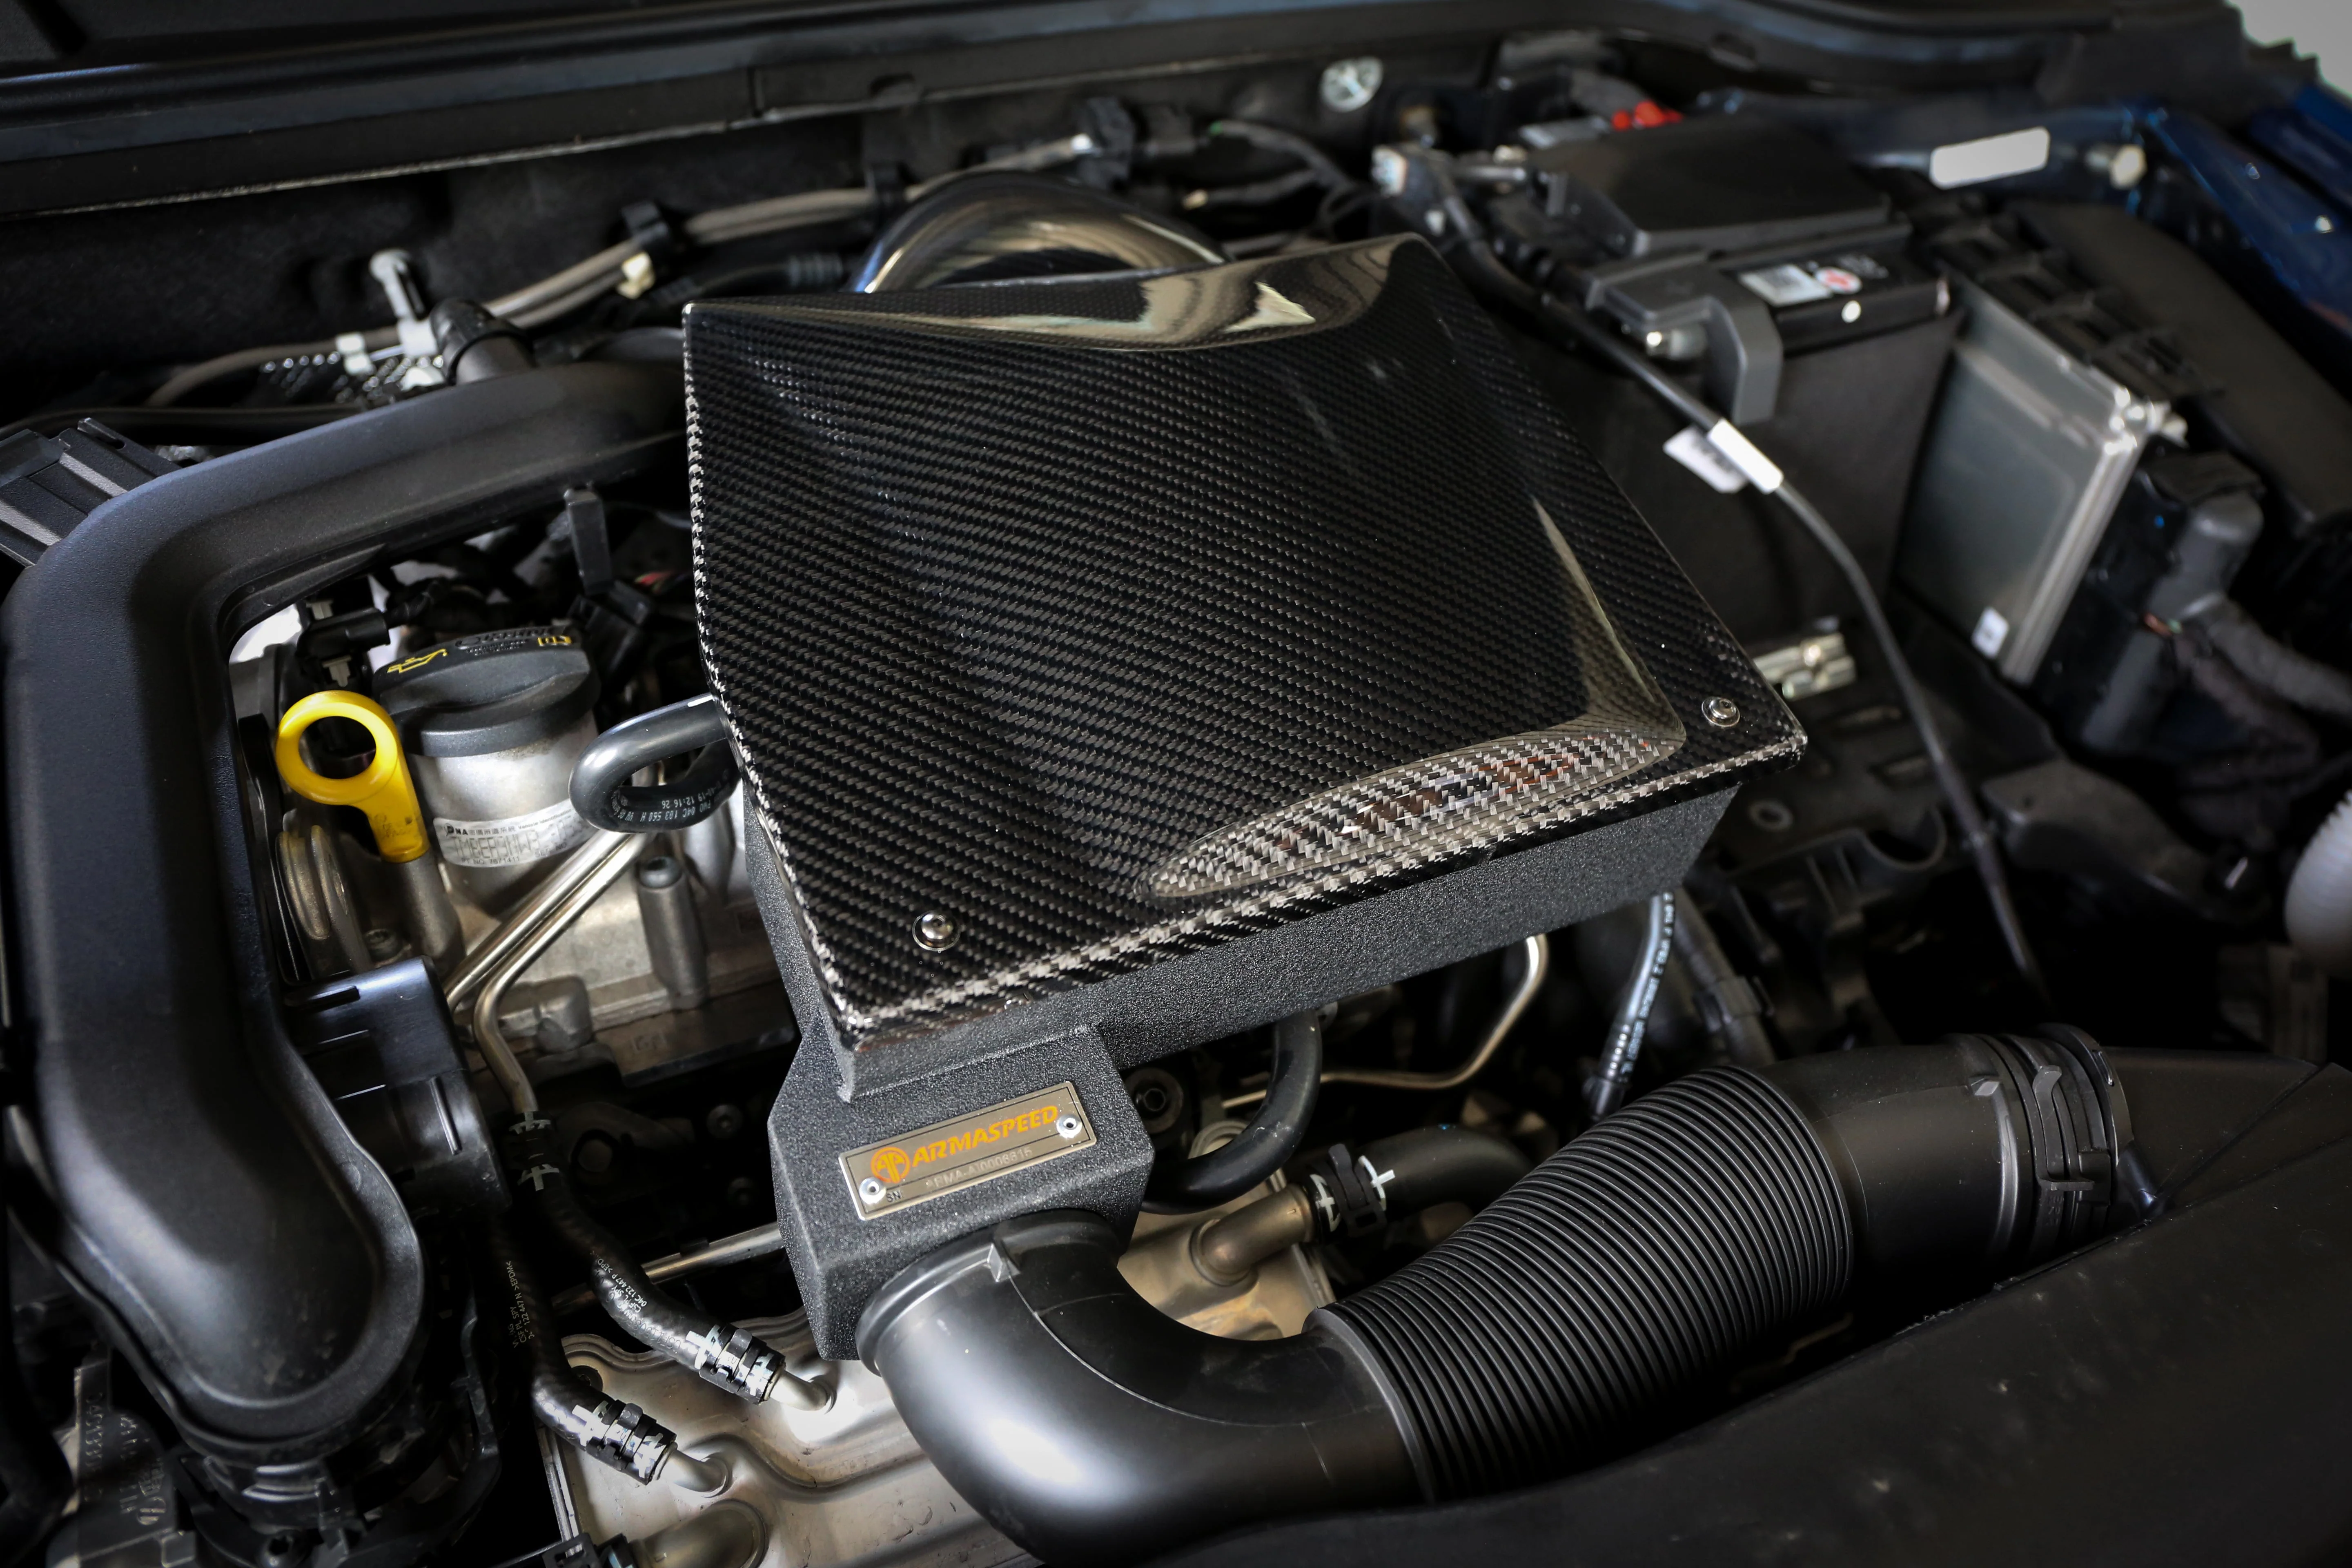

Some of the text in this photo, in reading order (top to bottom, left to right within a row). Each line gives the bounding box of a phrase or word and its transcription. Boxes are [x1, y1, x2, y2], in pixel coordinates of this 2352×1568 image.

[539, 808, 572, 824] Identification
[640, 812, 647, 822] H
[665, 810, 678, 820] 103
[912, 1105, 1058, 1167] ARMASPEED
[615, 1277, 627, 1287] 447
[625, 1285, 637, 1298] 122
[611, 1285, 641, 1313] CSF PL SPY
[634, 1294, 647, 1307] 04C
[517, 1301, 525, 1312] 447
[510, 1307, 527, 1343] CSF PL SPY
[521, 1312, 530, 1325] 122
